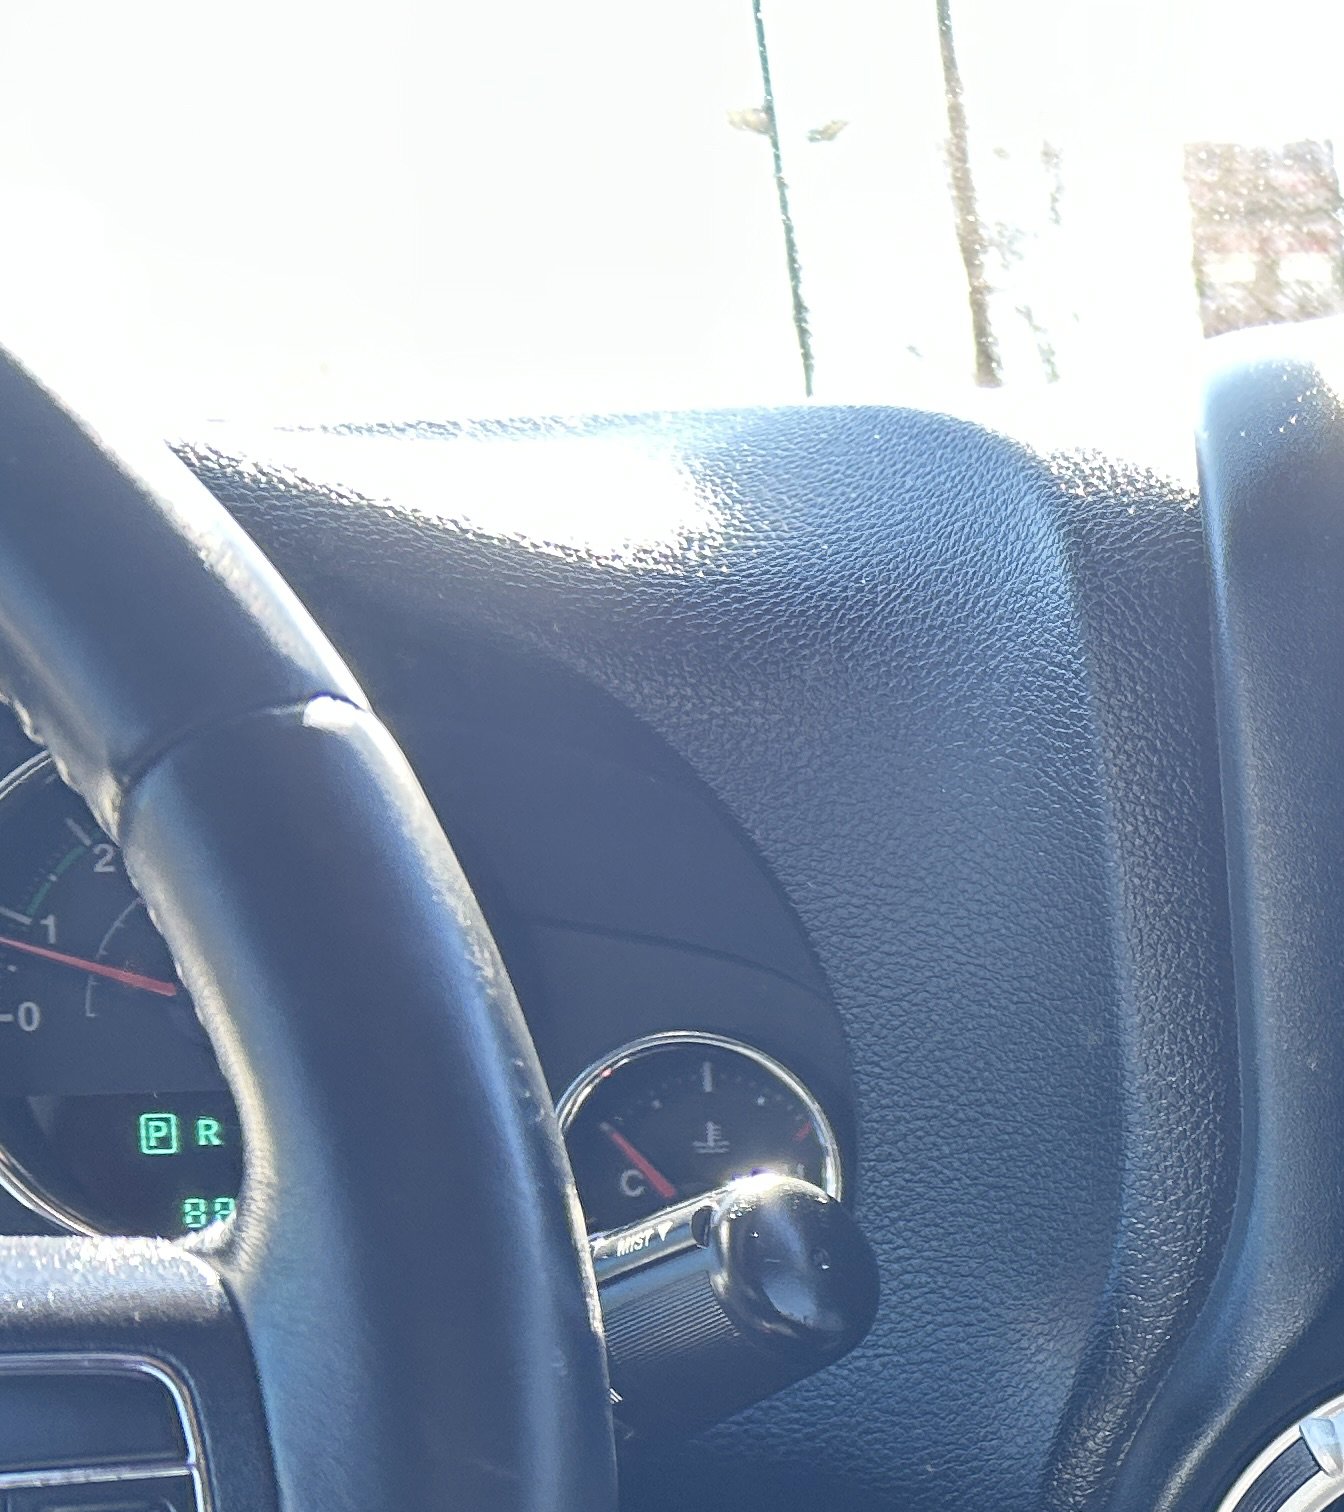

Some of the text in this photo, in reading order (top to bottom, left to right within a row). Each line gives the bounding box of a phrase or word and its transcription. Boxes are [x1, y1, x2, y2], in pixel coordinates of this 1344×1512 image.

[148, 1117, 224, 1147] P R
[616, 1230, 656, 1258] MIST
